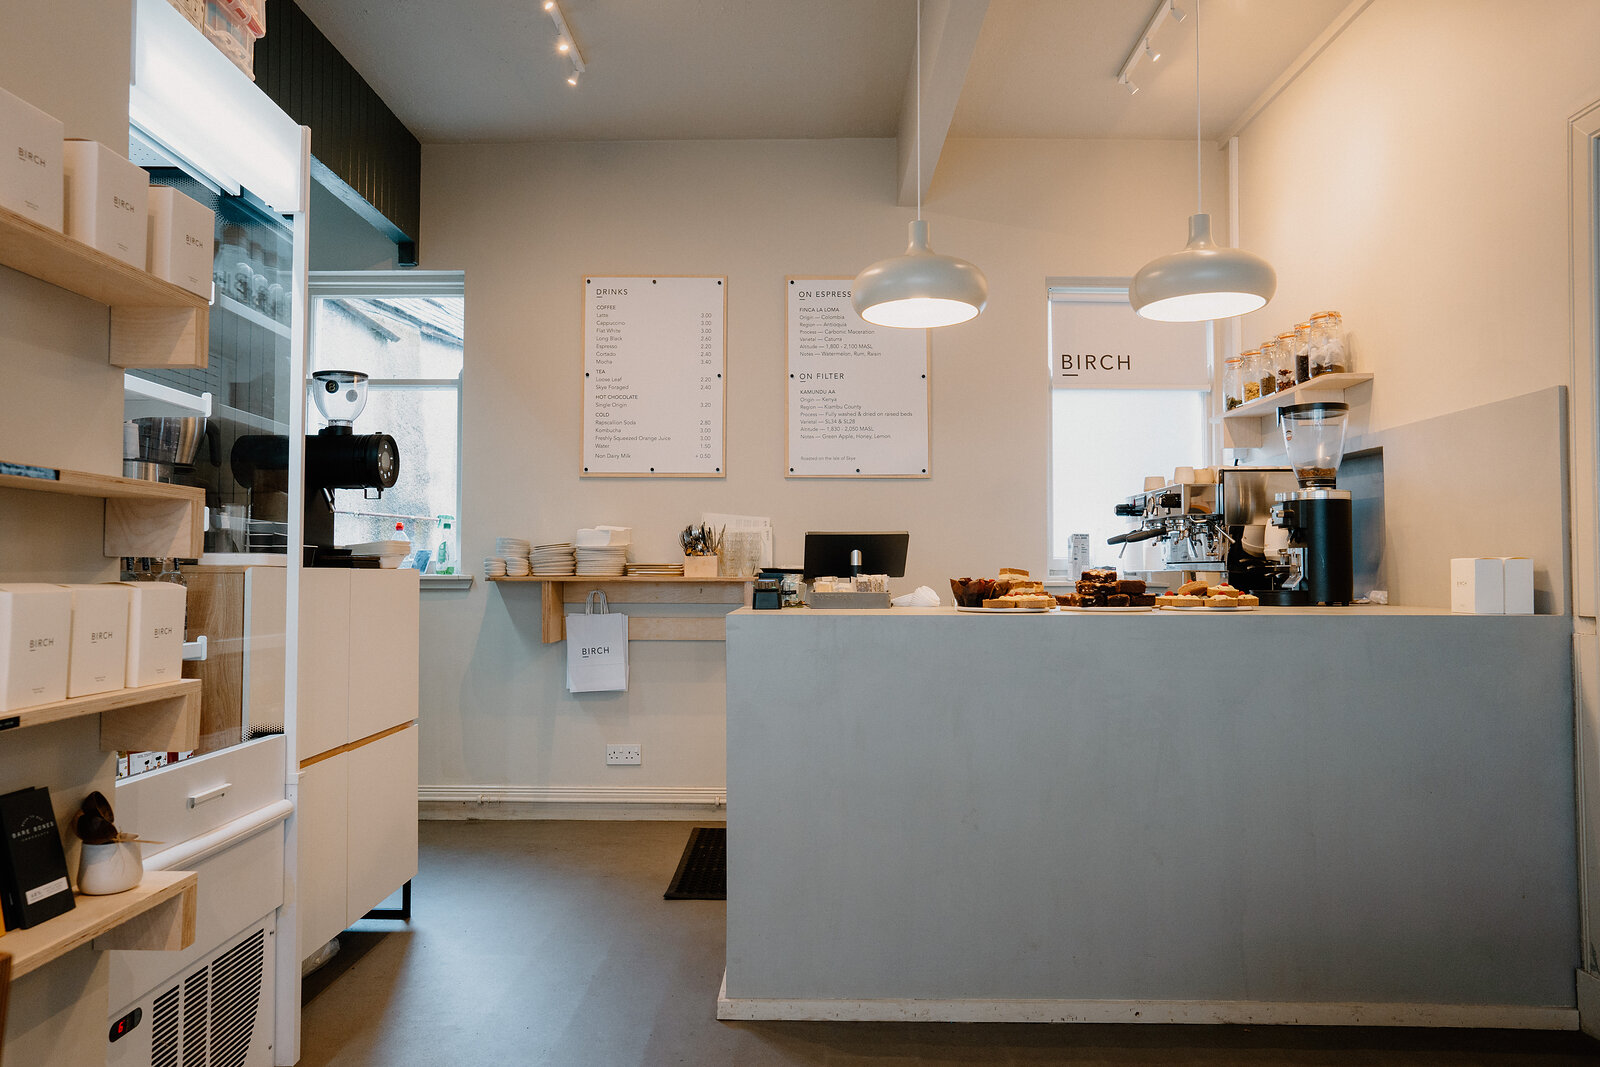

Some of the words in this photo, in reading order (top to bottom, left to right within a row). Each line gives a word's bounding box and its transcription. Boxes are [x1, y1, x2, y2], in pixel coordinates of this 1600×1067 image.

[18, 147, 46, 167] BIRCH
[114, 196, 134, 213] BIRCH
[186, 235, 203, 248] BIRCH
[1062, 355, 1131, 370] BIRCH
[91, 632, 113, 640] BIRCH
[154, 628, 172, 636] BIRCH
[29, 639, 54, 649] BIRCH
[582, 647, 610, 655] BIRCH
[118, 1022, 123, 1033] 6
